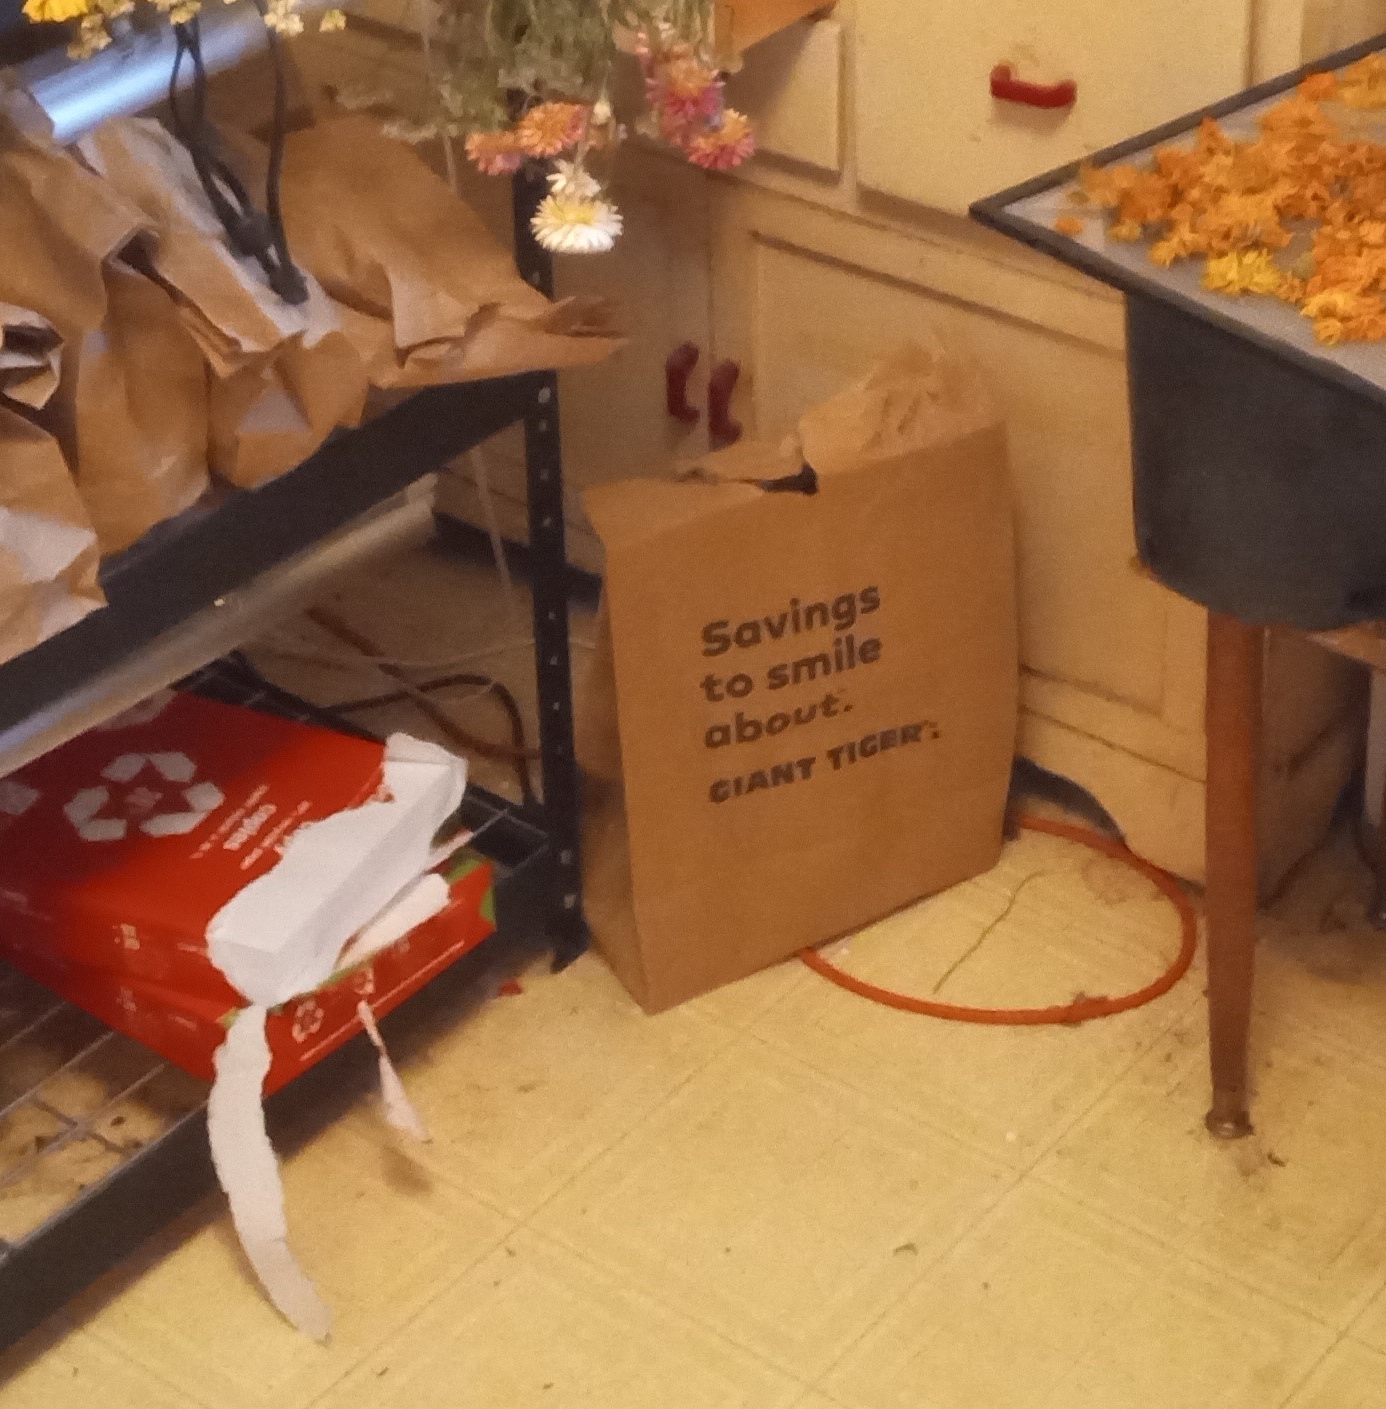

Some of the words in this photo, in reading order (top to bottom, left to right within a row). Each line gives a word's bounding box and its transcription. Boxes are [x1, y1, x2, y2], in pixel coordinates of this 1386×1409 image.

[702, 585, 881, 657] Savings
[700, 673, 754, 702] to
[767, 634, 882, 690] smile
[709, 756, 816, 804] GIANT
